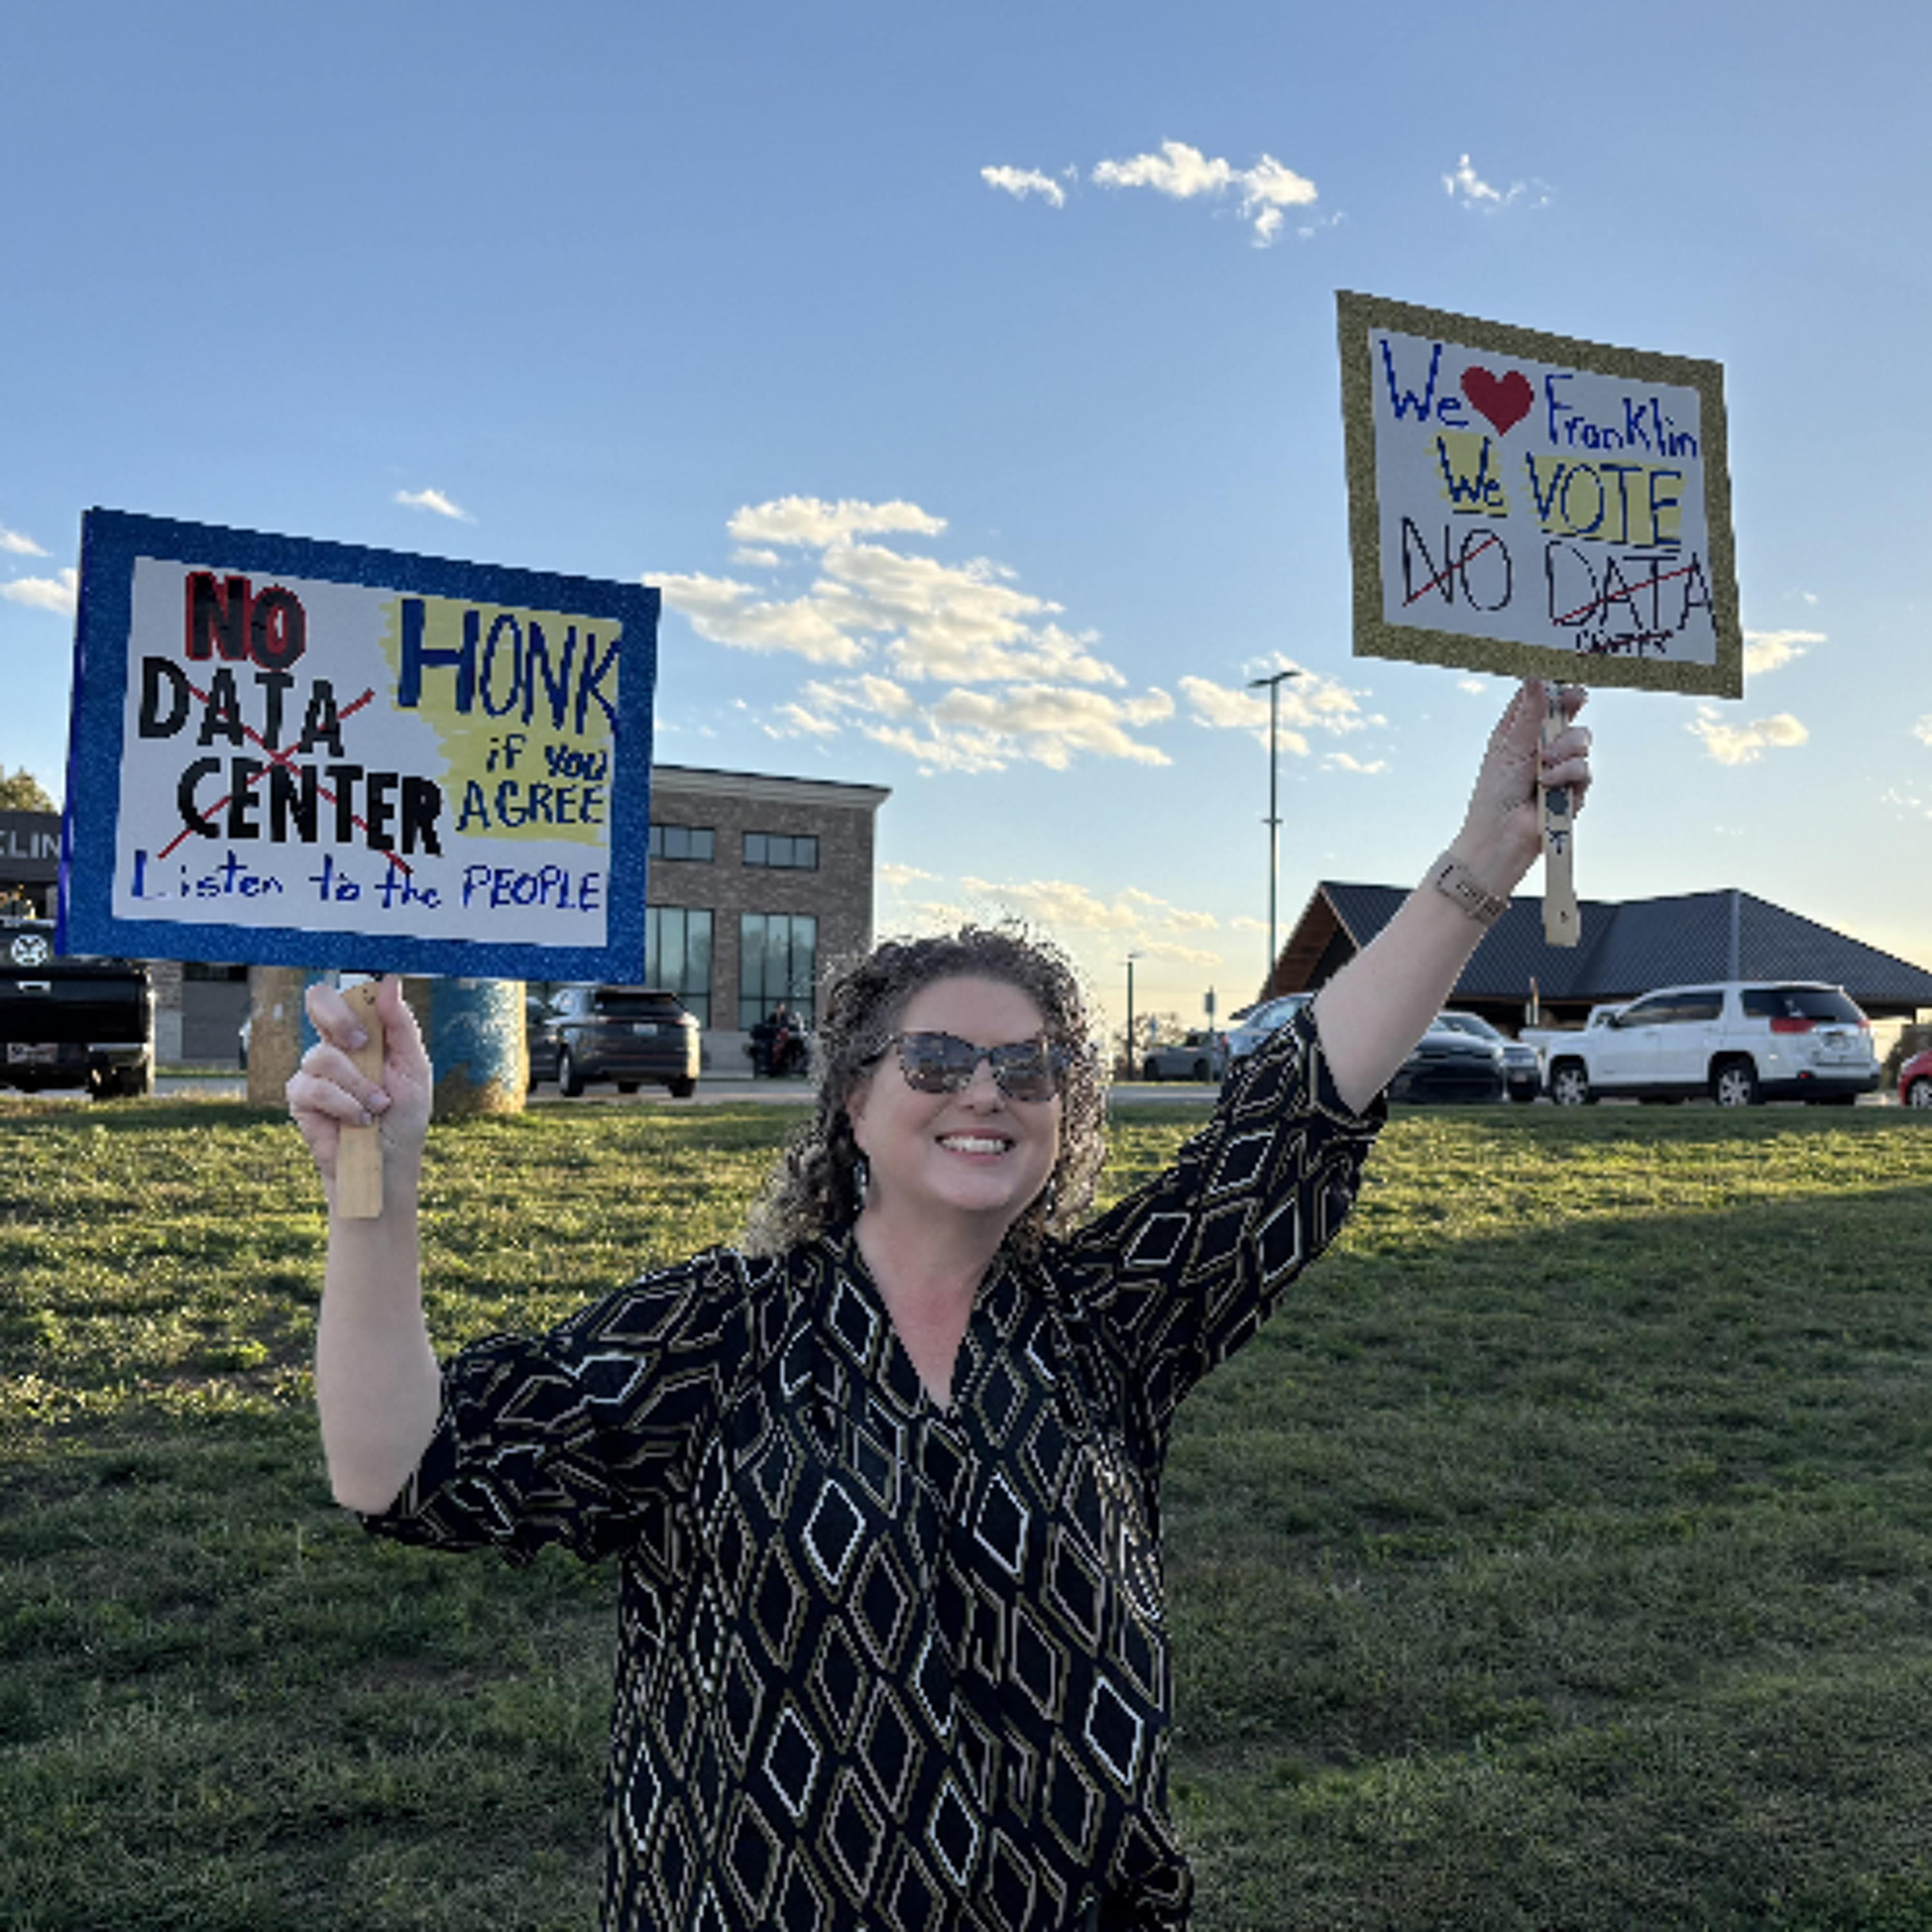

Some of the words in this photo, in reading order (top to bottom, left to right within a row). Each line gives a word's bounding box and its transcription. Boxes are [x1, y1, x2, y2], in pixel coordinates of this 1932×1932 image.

[1379, 339, 1470, 428] We
[1436, 435, 1504, 507] We
[1525, 451, 1682, 545] VOTE
[185, 571, 306, 671] NO
[1401, 516, 1512, 611] NO
[1545, 541, 1720, 637] DATA
[138, 656, 345, 758] DATA
[397, 598, 621, 739] HONK
[176, 757, 444, 857] CENTER
[455, 780, 603, 831] AGREE
[131, 849, 283, 900] Listen
[309, 854, 361, 902] to
[375, 862, 442, 909] the
[462, 865, 600, 911] PEOPLE
